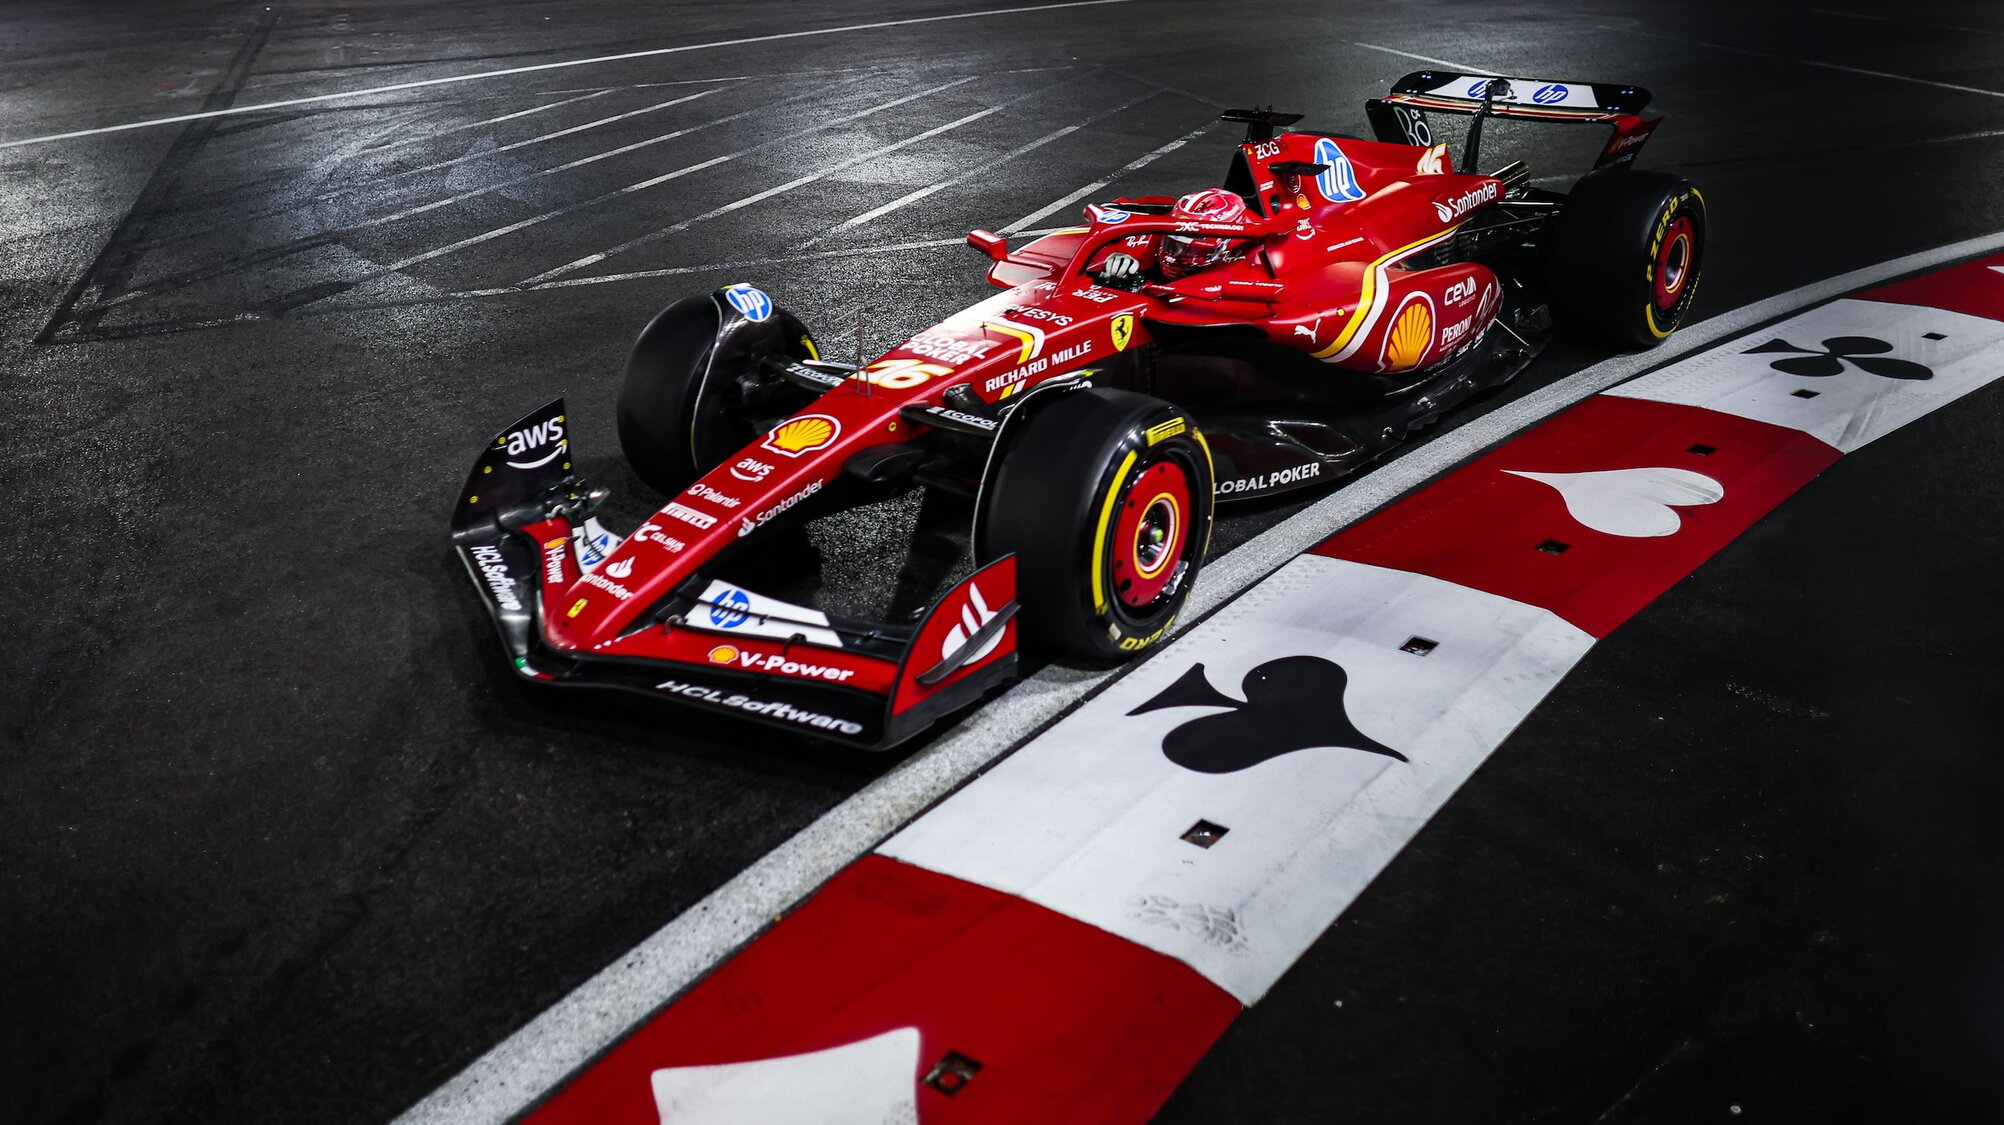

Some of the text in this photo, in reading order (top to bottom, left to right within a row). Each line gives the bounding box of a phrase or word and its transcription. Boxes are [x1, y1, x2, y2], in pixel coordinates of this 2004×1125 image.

[1533, 85, 1568, 104] hp
[1314, 138, 1366, 202] hp
[1447, 183, 1497, 218] Santander
[1651, 196, 1679, 260] ZERO
[726, 287, 772, 322] hp
[1440, 315, 1472, 346] PERONI
[898, 341, 971, 366] POKER
[985, 357, 1048, 393] RICHARD
[1051, 340, 1092, 368] MILLE
[850, 358, 954, 390] 16
[943, 409, 999, 428] ECOPOL
[507, 416, 564, 456] aws
[736, 457, 775, 477] aws
[1213, 461, 1320, 495] LOBAL POKER
[698, 487, 741, 509] Palantir
[756, 478, 825, 527] Santander
[660, 502, 718, 530] PIRELLI
[710, 588, 750, 629] hp
[738, 651, 855, 683] V-Power
[655, 679, 863, 736] HCLSoftware
